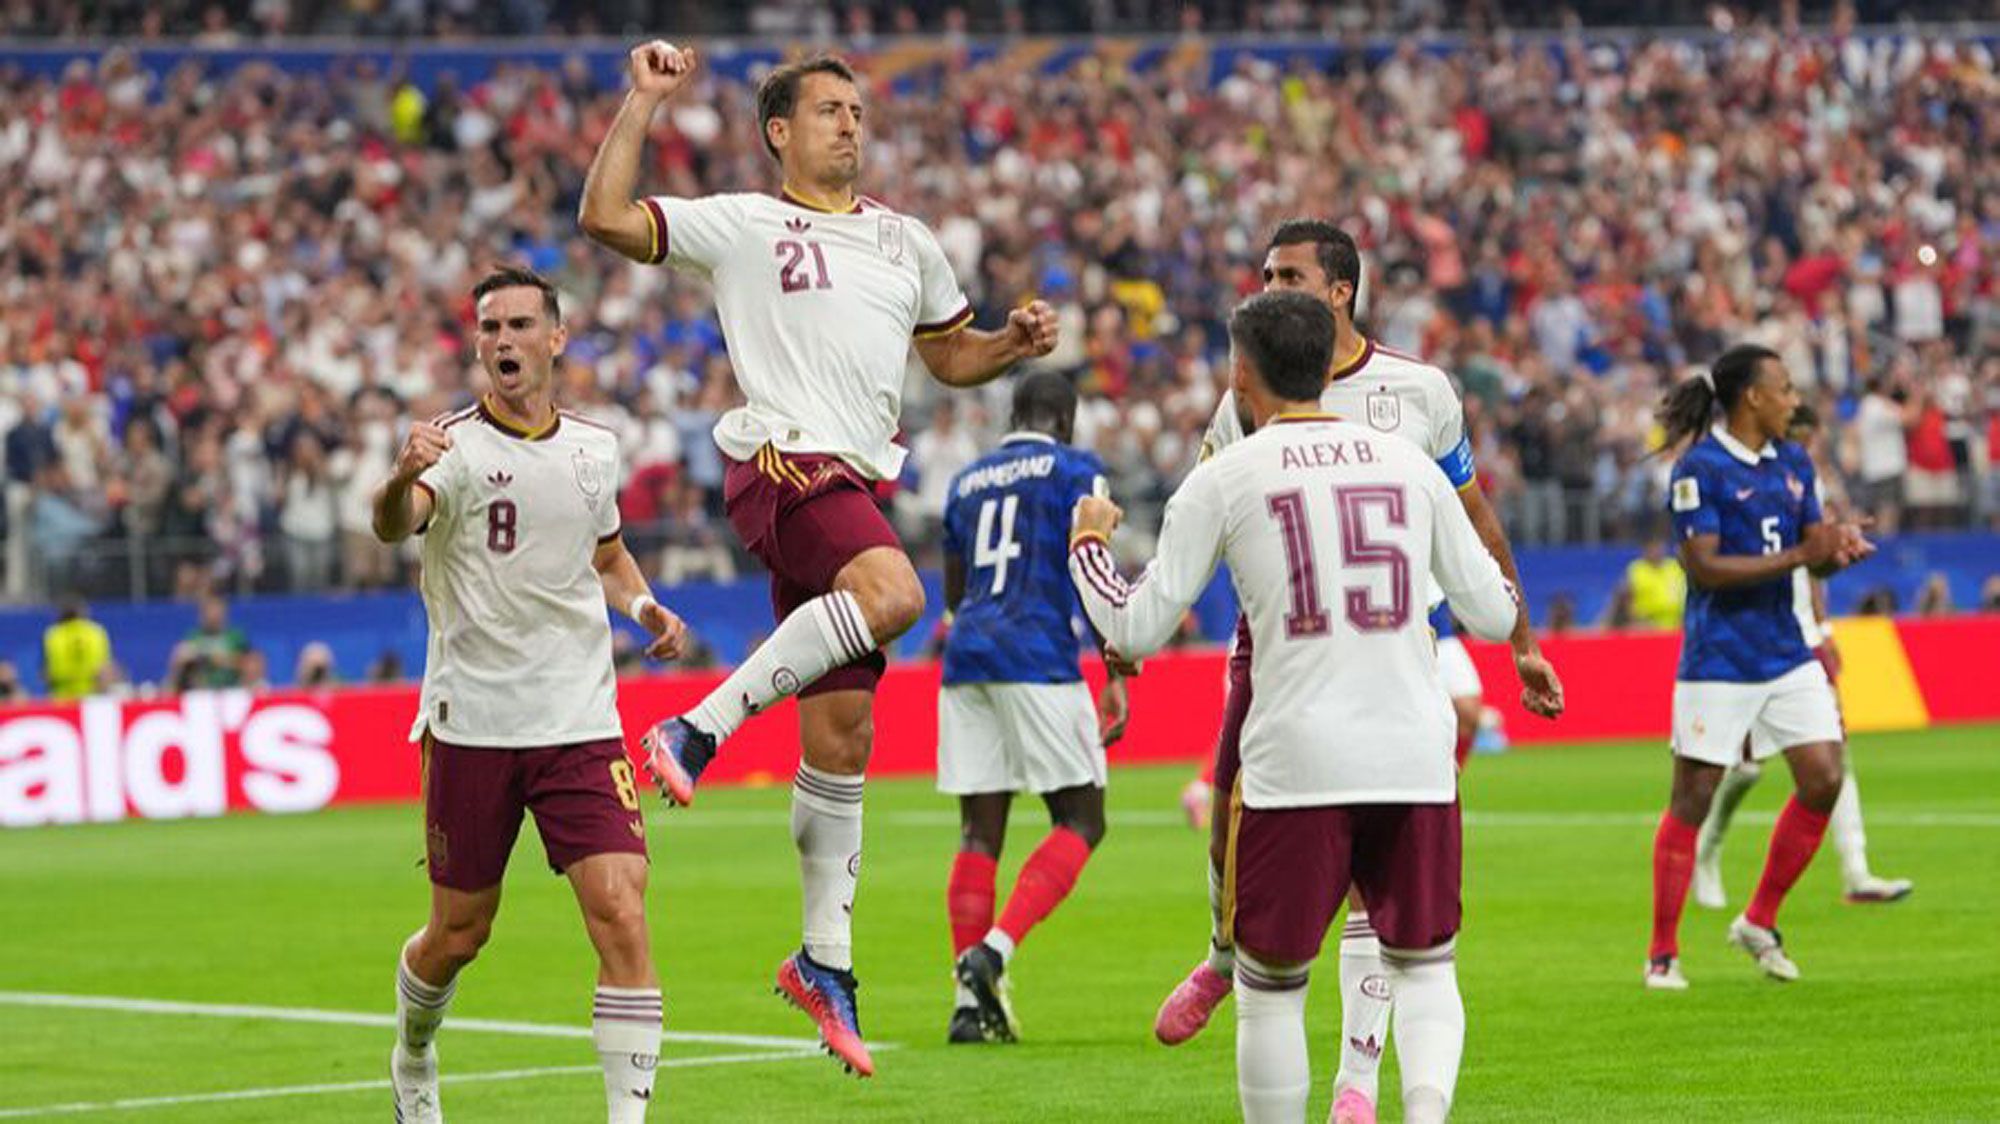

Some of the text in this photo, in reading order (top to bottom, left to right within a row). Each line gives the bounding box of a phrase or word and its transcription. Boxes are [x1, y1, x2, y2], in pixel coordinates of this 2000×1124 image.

[775, 240, 832, 294] 21
[1282, 440, 1381, 470] ALEX B.
[487, 499, 517, 554] 8
[974, 494, 1021, 596] 4
[1760, 515, 1782, 555] 5
[1264, 482, 1412, 640] 15
[0, 688, 340, 827] ald's
[609, 759, 639, 811] 8
